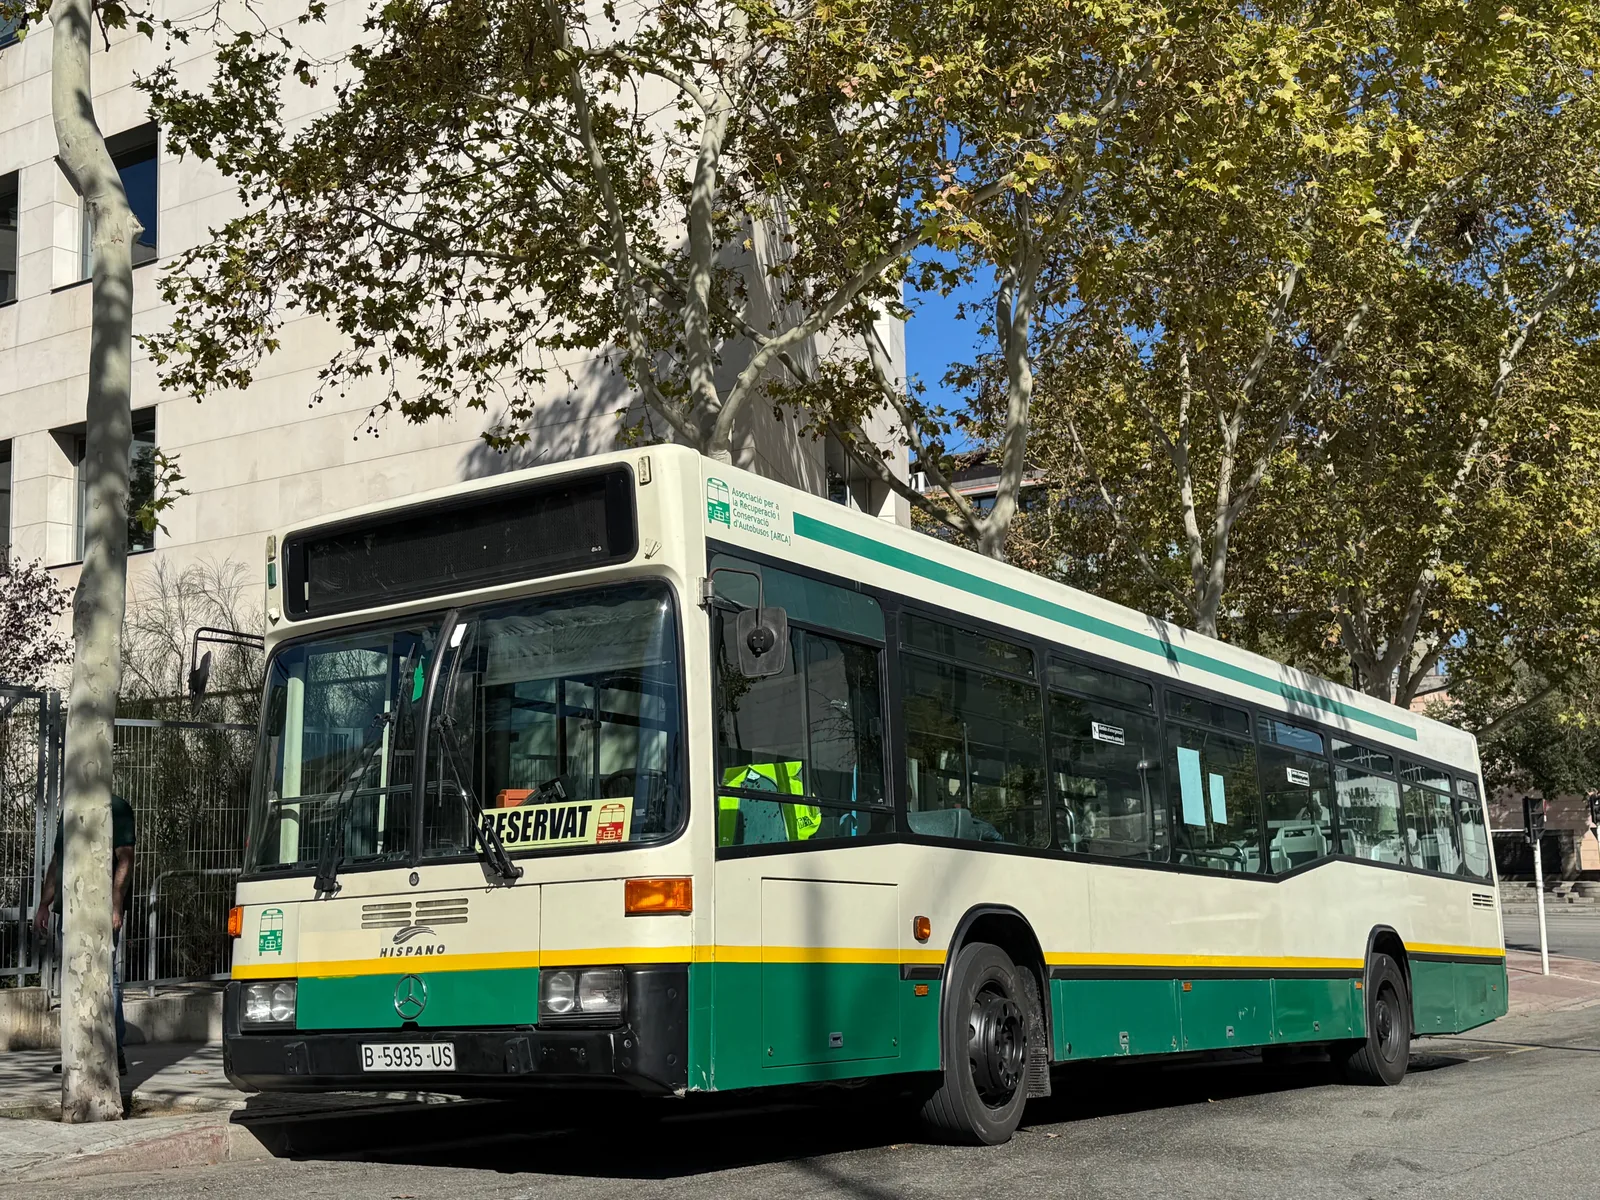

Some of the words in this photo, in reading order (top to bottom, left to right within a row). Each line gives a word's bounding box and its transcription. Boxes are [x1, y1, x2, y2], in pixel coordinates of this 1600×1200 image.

[732, 487, 763, 505] Associació
[764, 499, 774, 509] per
[733, 496, 739, 507] la
[740, 499, 777, 520] Recuperació
[733, 508, 770, 528] Conservació
[734, 519, 770, 538] d'Autobusos
[480, 805, 592, 845] RESERVAT
[379, 944, 446, 958] HISPANO
